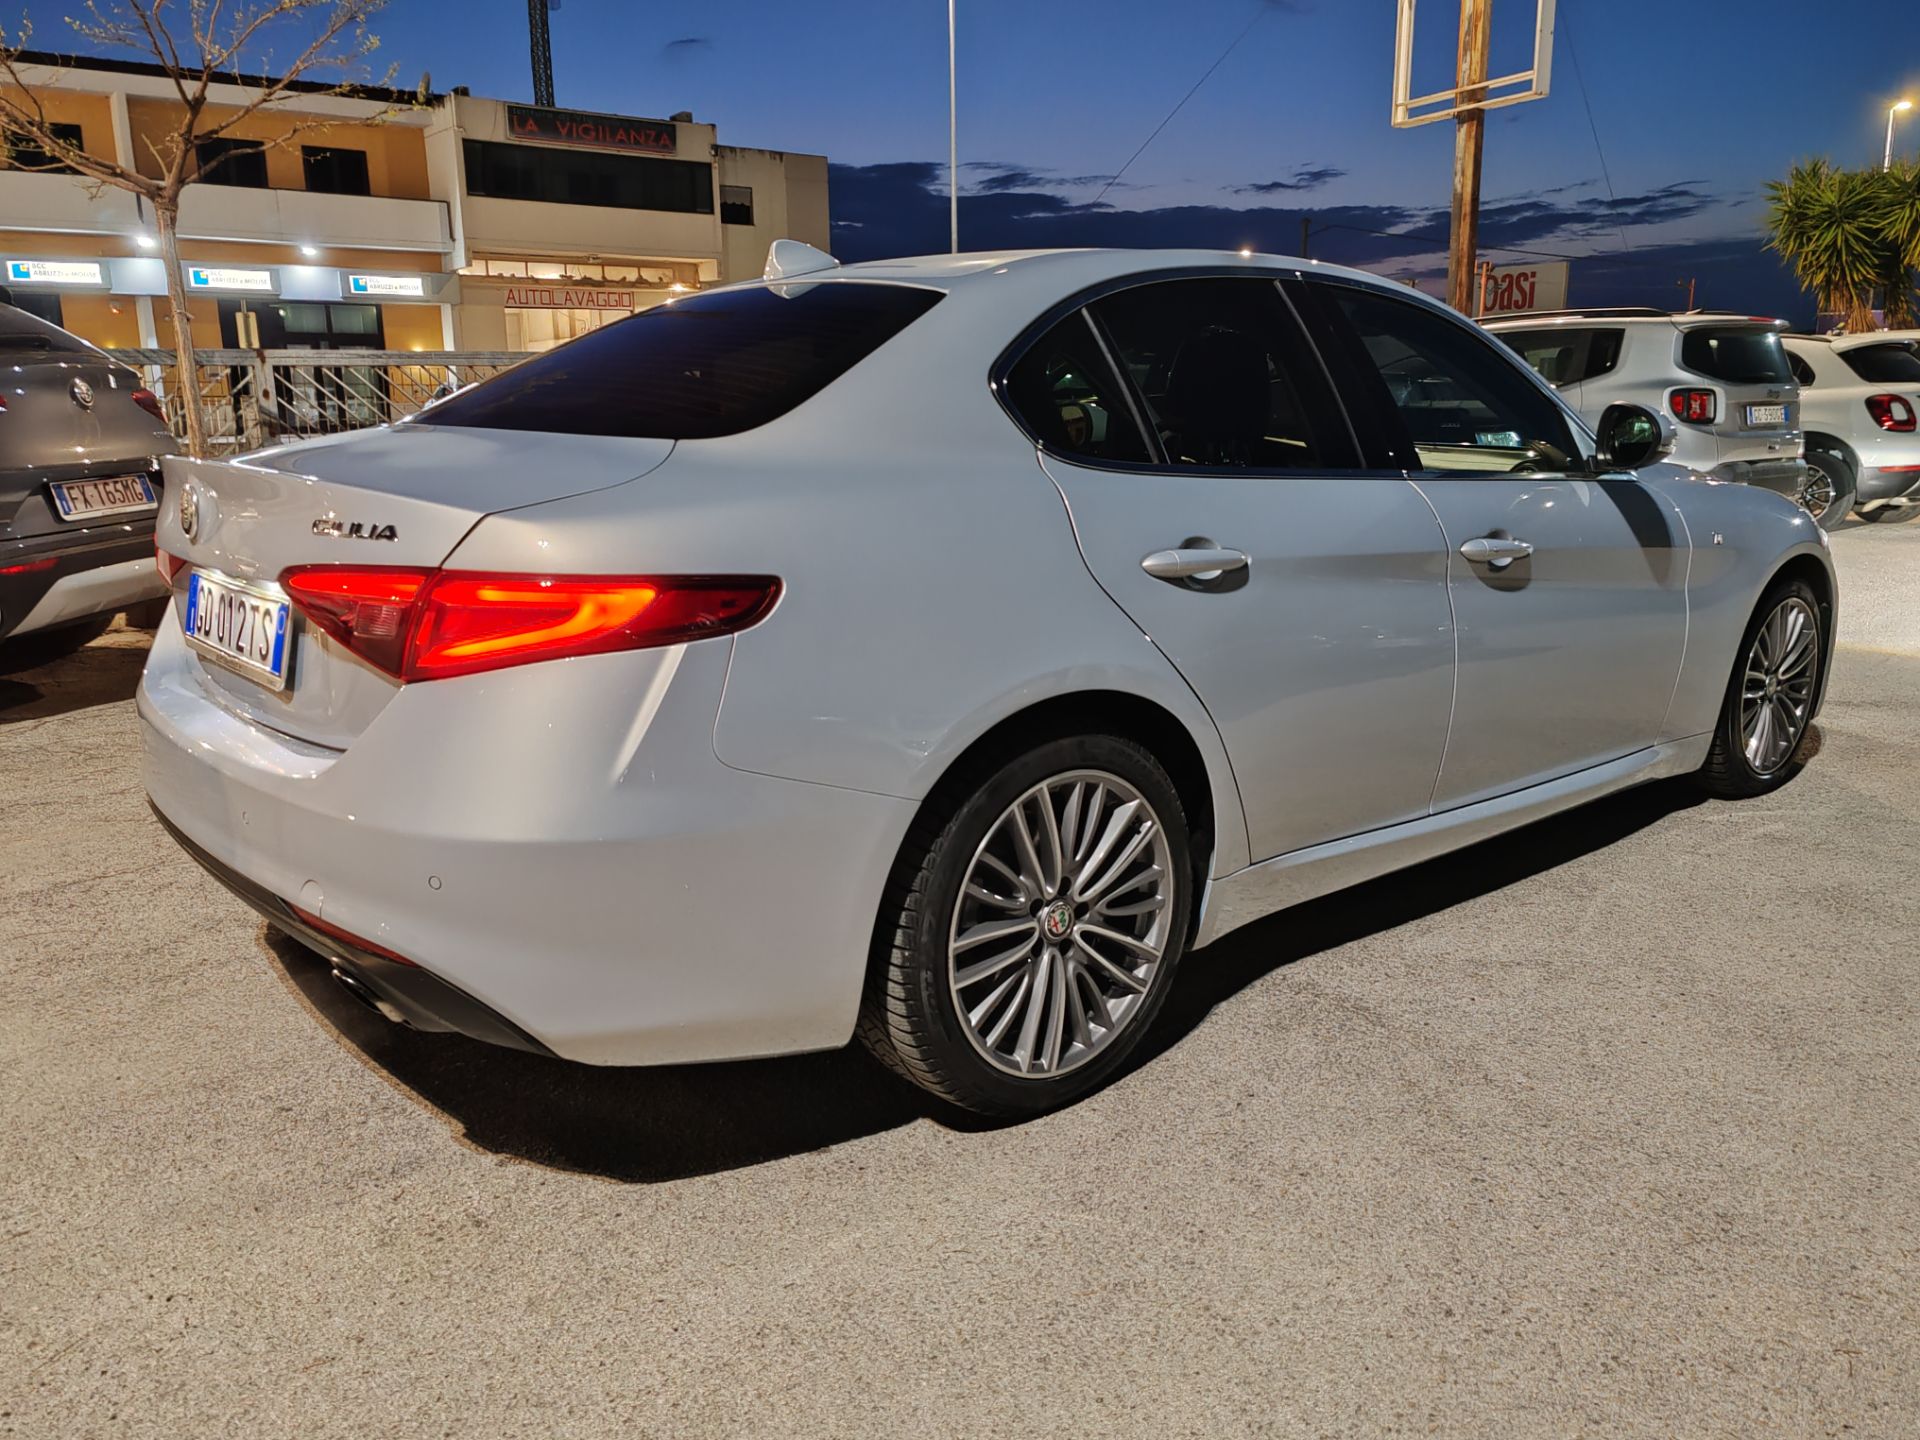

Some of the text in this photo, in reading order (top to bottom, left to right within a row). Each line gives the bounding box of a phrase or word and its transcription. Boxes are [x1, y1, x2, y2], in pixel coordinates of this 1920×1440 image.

[512, 115, 673, 147] LA VIGILANZA
[506, 288, 632, 307] AUTOLAVAGGIO
